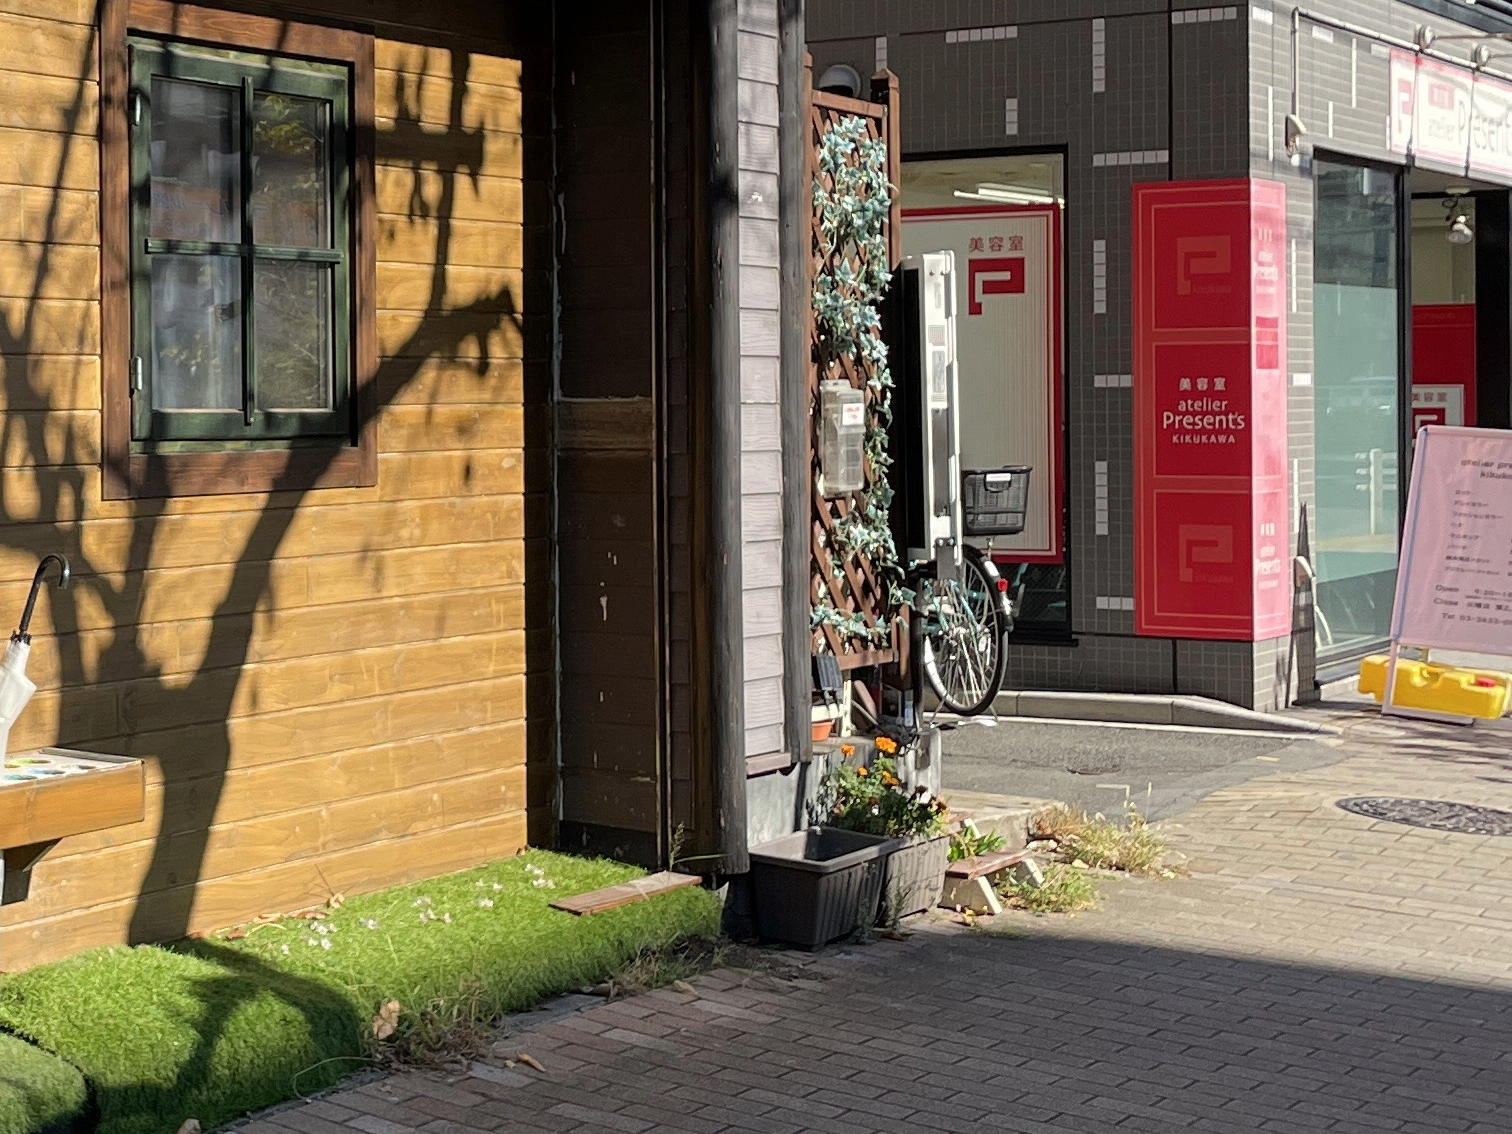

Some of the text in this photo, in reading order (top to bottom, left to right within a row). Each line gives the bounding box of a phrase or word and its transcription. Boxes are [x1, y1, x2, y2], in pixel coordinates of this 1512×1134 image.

[968, 236, 1024, 253] 美容室
[1178, 396, 1228, 412] atelier
[1172, 433, 1236, 444] KIKUKAWA
